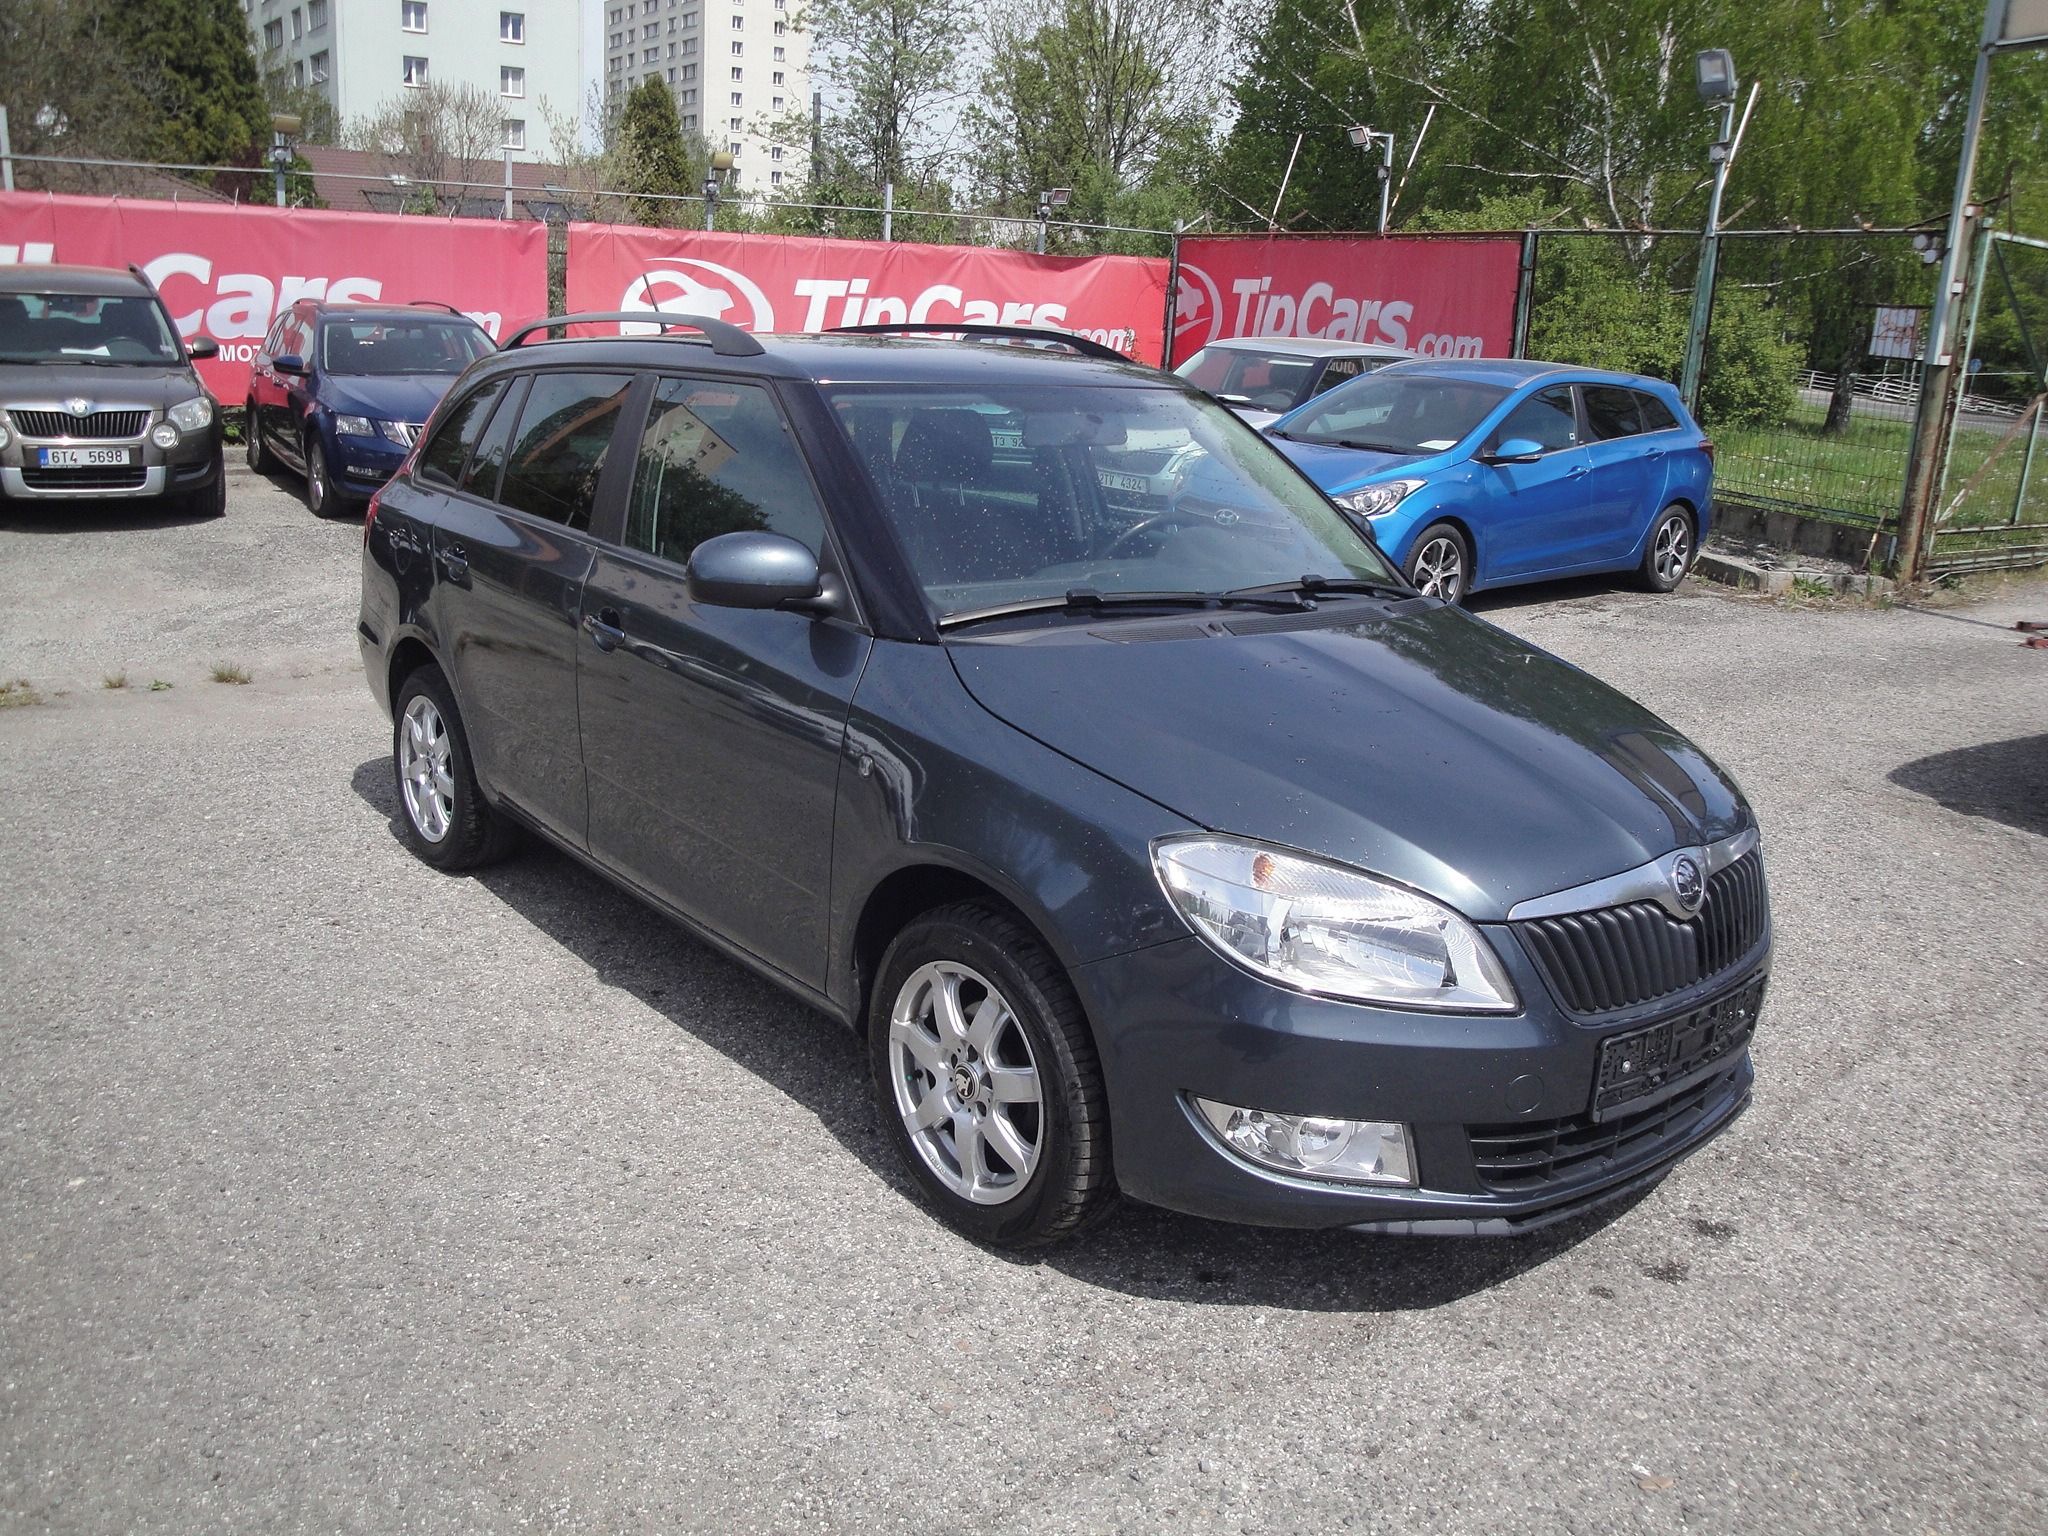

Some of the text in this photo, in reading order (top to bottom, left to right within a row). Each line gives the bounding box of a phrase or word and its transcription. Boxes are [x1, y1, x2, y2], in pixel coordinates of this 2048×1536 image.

[51, 451, 78, 463] 6T4
[88, 450, 123, 463] 5698
[1121, 476, 1142, 491] 4324
